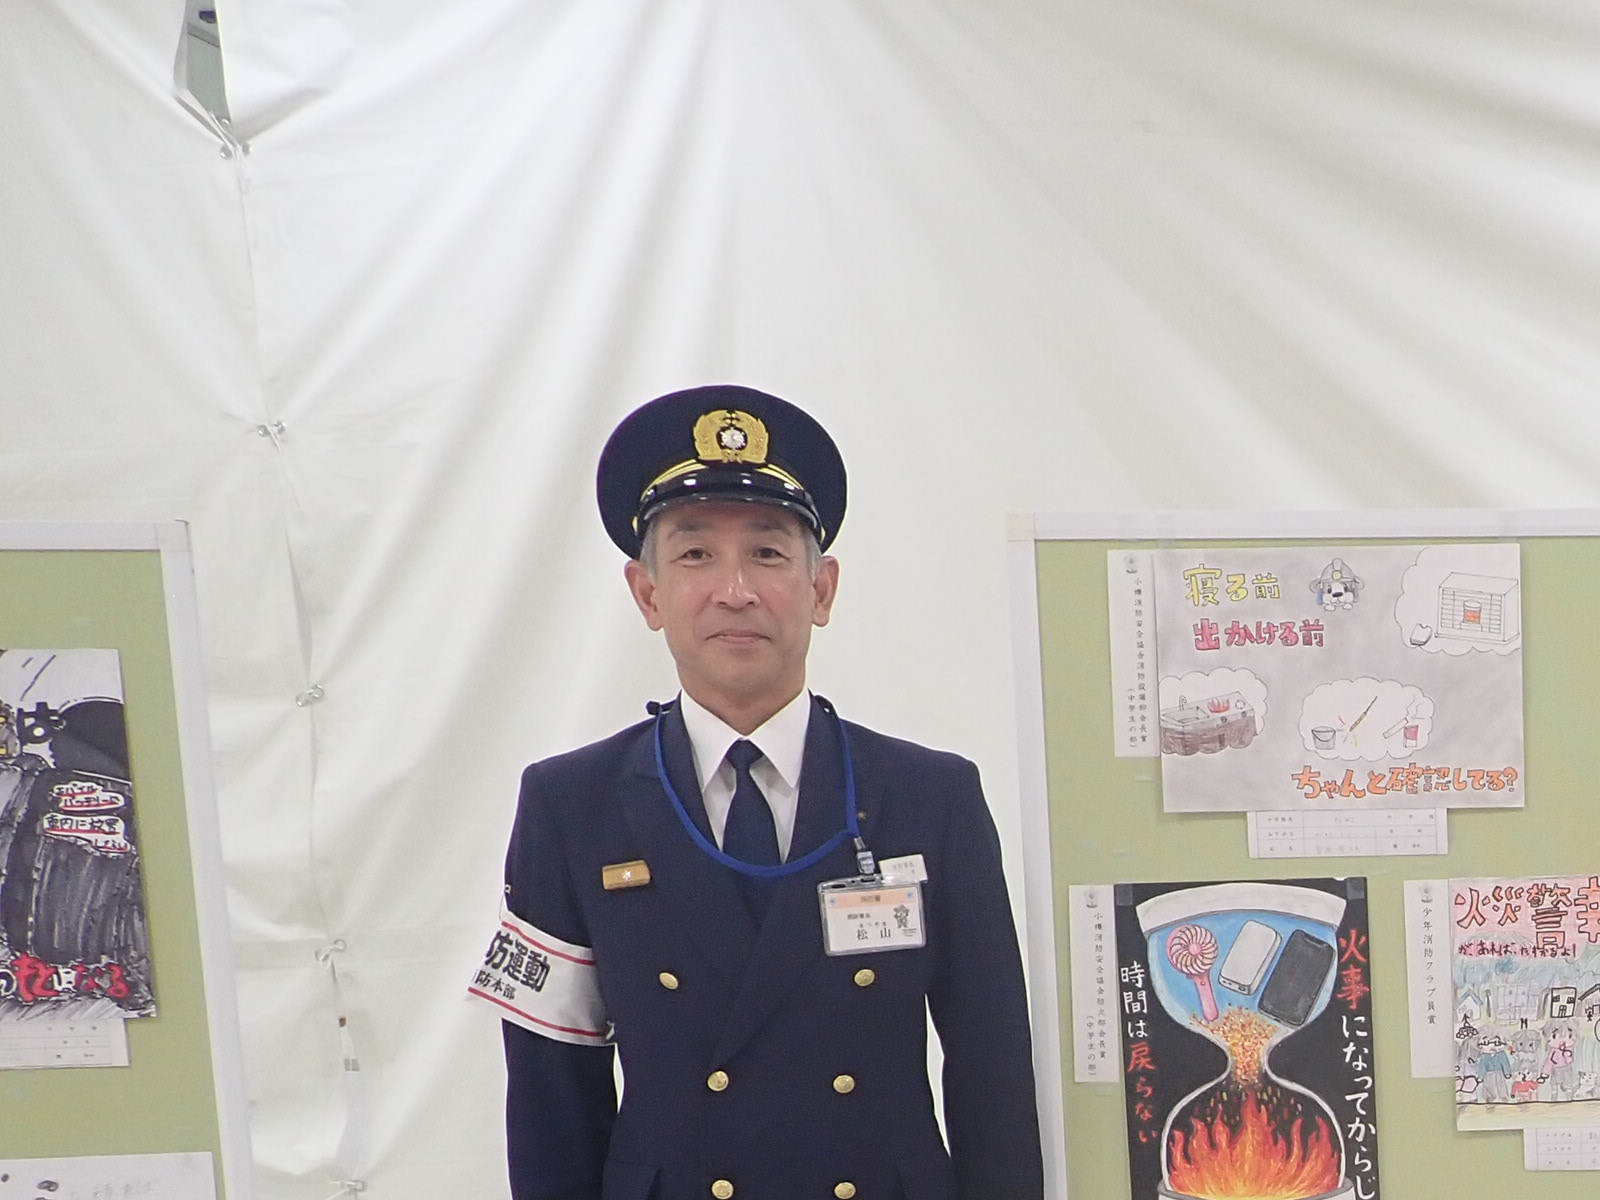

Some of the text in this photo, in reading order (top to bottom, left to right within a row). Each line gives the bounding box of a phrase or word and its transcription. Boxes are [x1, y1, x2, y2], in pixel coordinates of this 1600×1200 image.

[1183, 563, 1281, 607] 寝る前
[1193, 618, 1325, 652] 出かける前
[1292, 763, 1519, 799] ちゃんと確認してる?
[471, 968, 517, 1000] 防本部
[1422, 906, 1437, 1025] 少年消防クラブ員賞
[1119, 964, 1158, 1143] 時間は戻らない
